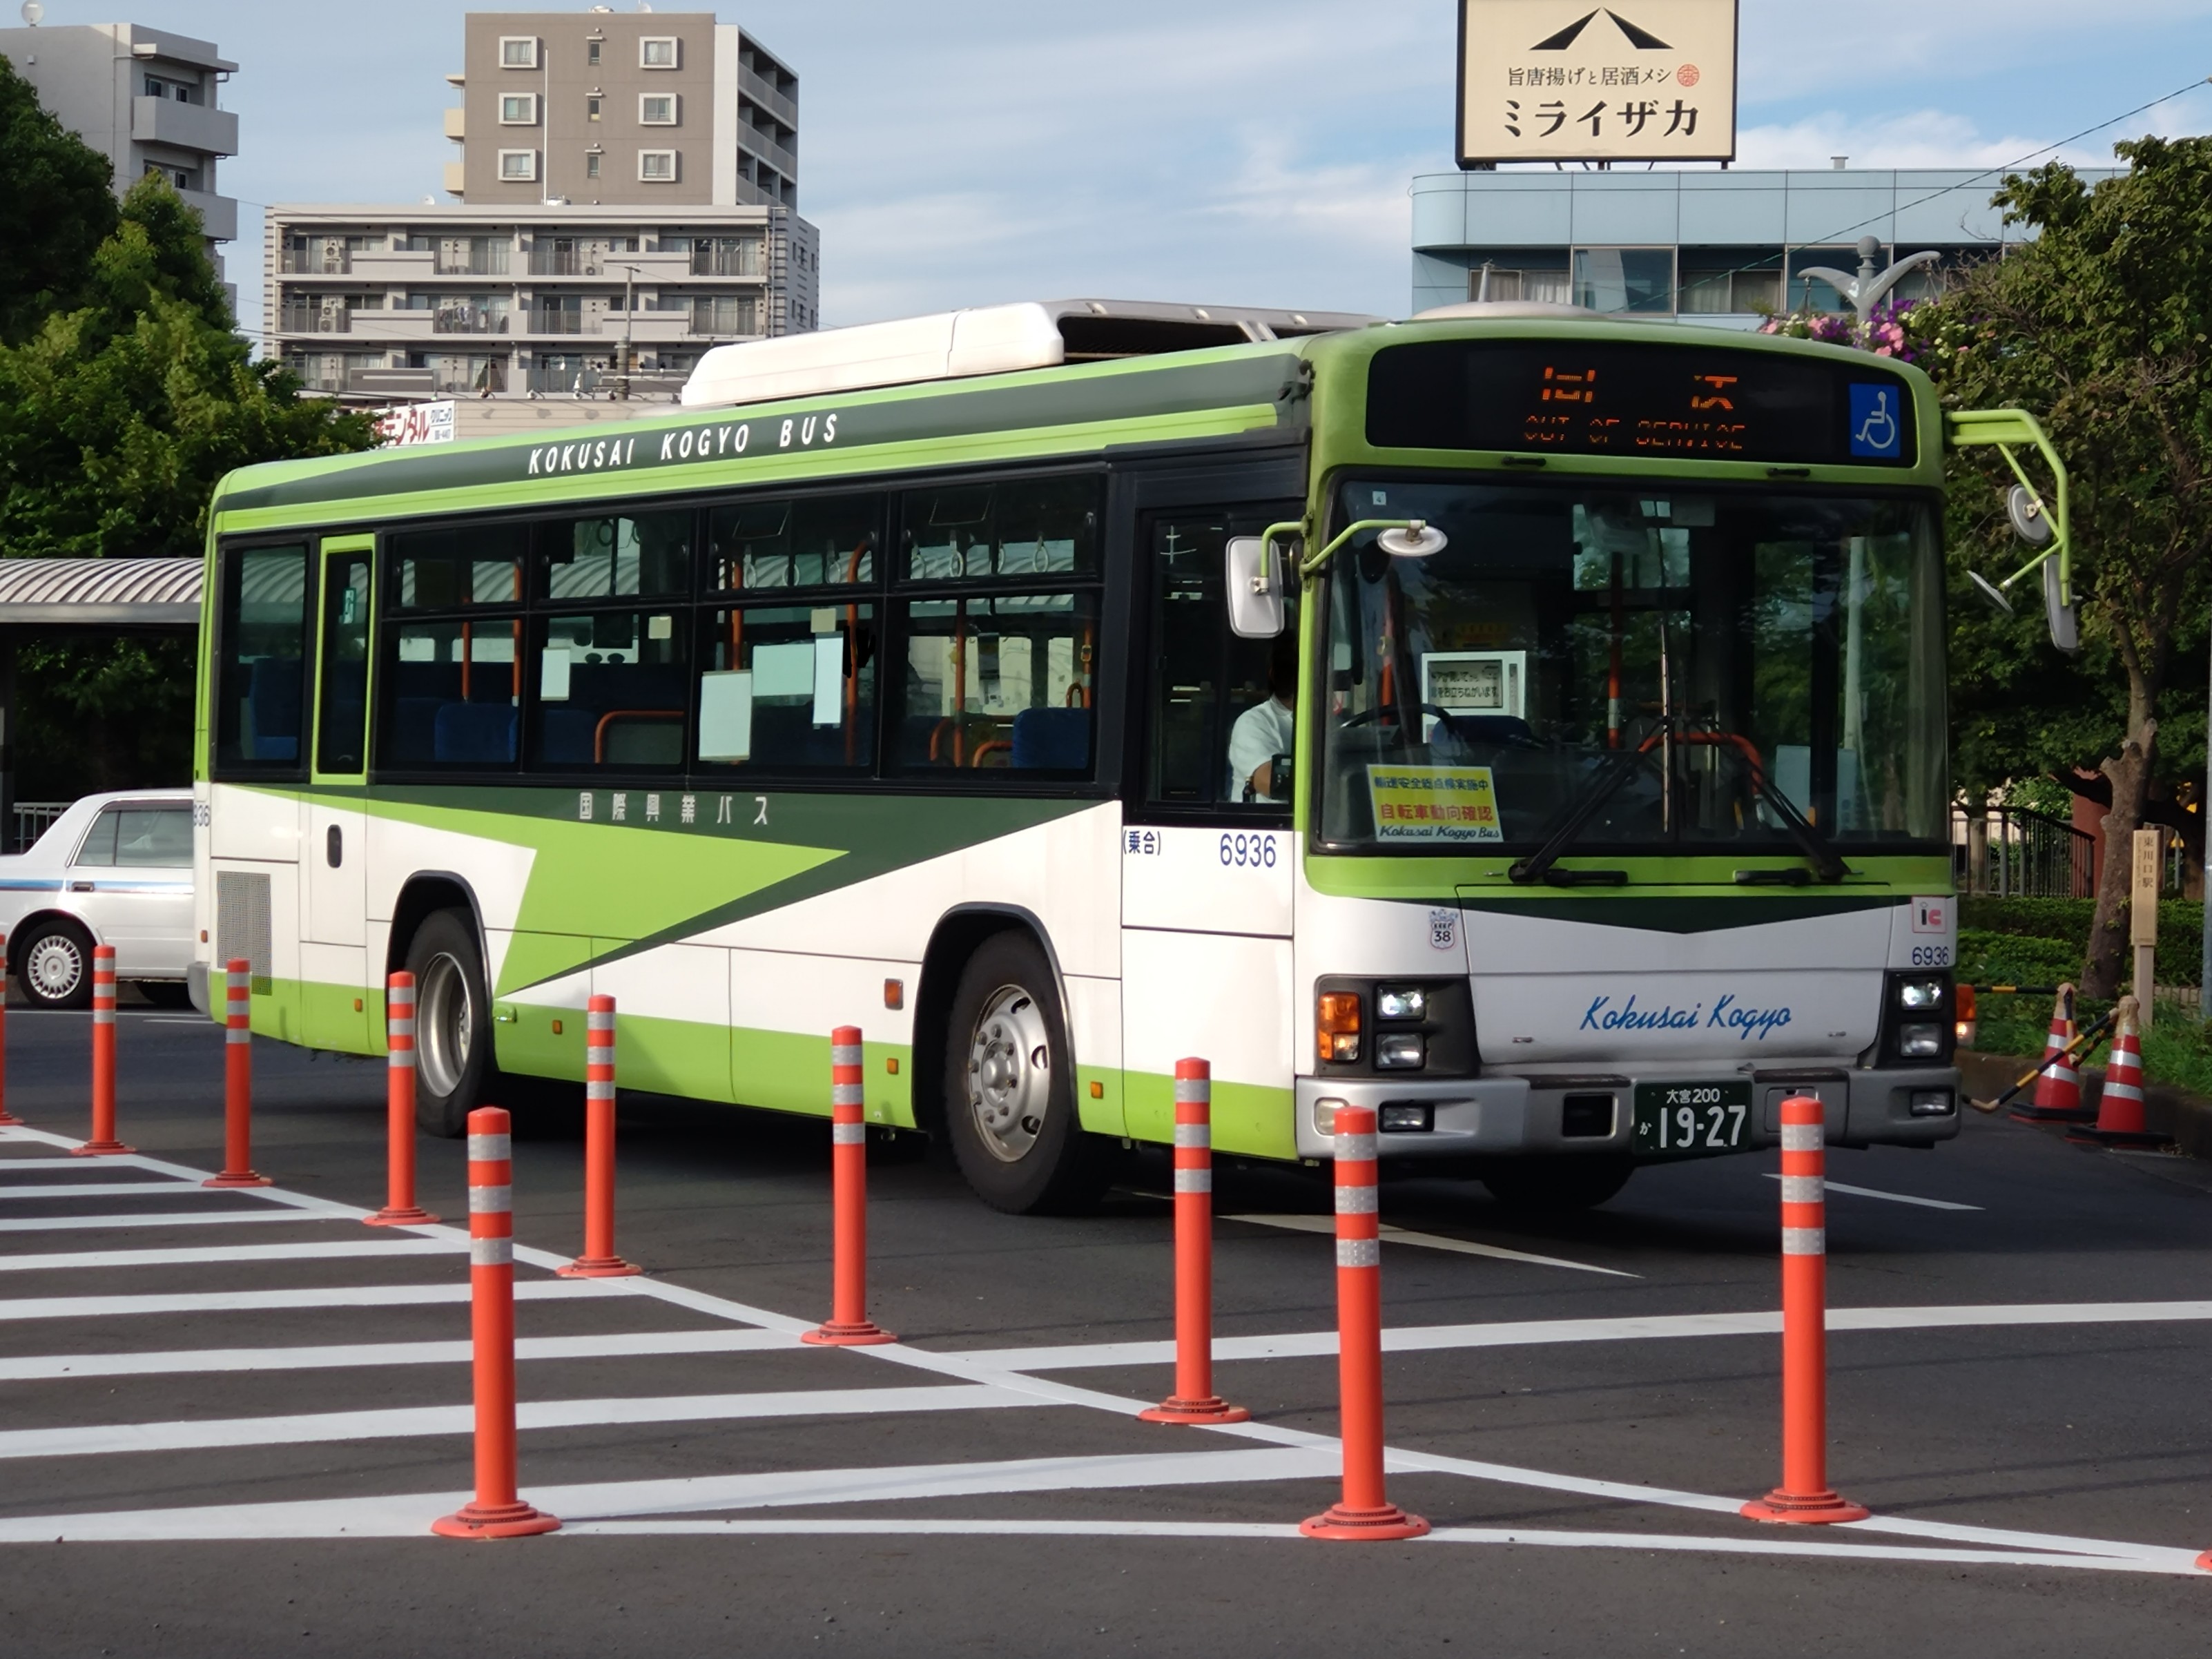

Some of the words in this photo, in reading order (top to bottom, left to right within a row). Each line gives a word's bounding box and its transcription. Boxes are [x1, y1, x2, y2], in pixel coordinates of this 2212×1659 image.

[1507, 66, 1672, 87] 旨唐揚げと居酒メシ
[1504, 99, 1699, 137] ミライザカ
[527, 438, 634, 475] KOKUSAI
[660, 424, 749, 460] KOGYO
[779, 414, 837, 447] BUS
[579, 792, 768, 825] 国際興業バス
[1123, 829, 1161, 856] (乗合)
[1379, 825, 1433, 837] Kokusai
[1436, 825, 1477, 840] Kogyo
[1478, 826, 1500, 838] Bus
[1220, 833, 1277, 868] 6936
[2142, 836, 2154, 889] 東川口駅
[1434, 930, 1451, 942] 38
[1912, 946, 1949, 966] 6936
[1579, 994, 1702, 1031] Kokusai
[1706, 993, 1792, 1040] Kogyo
[1659, 1105, 1747, 1149] 19-27
